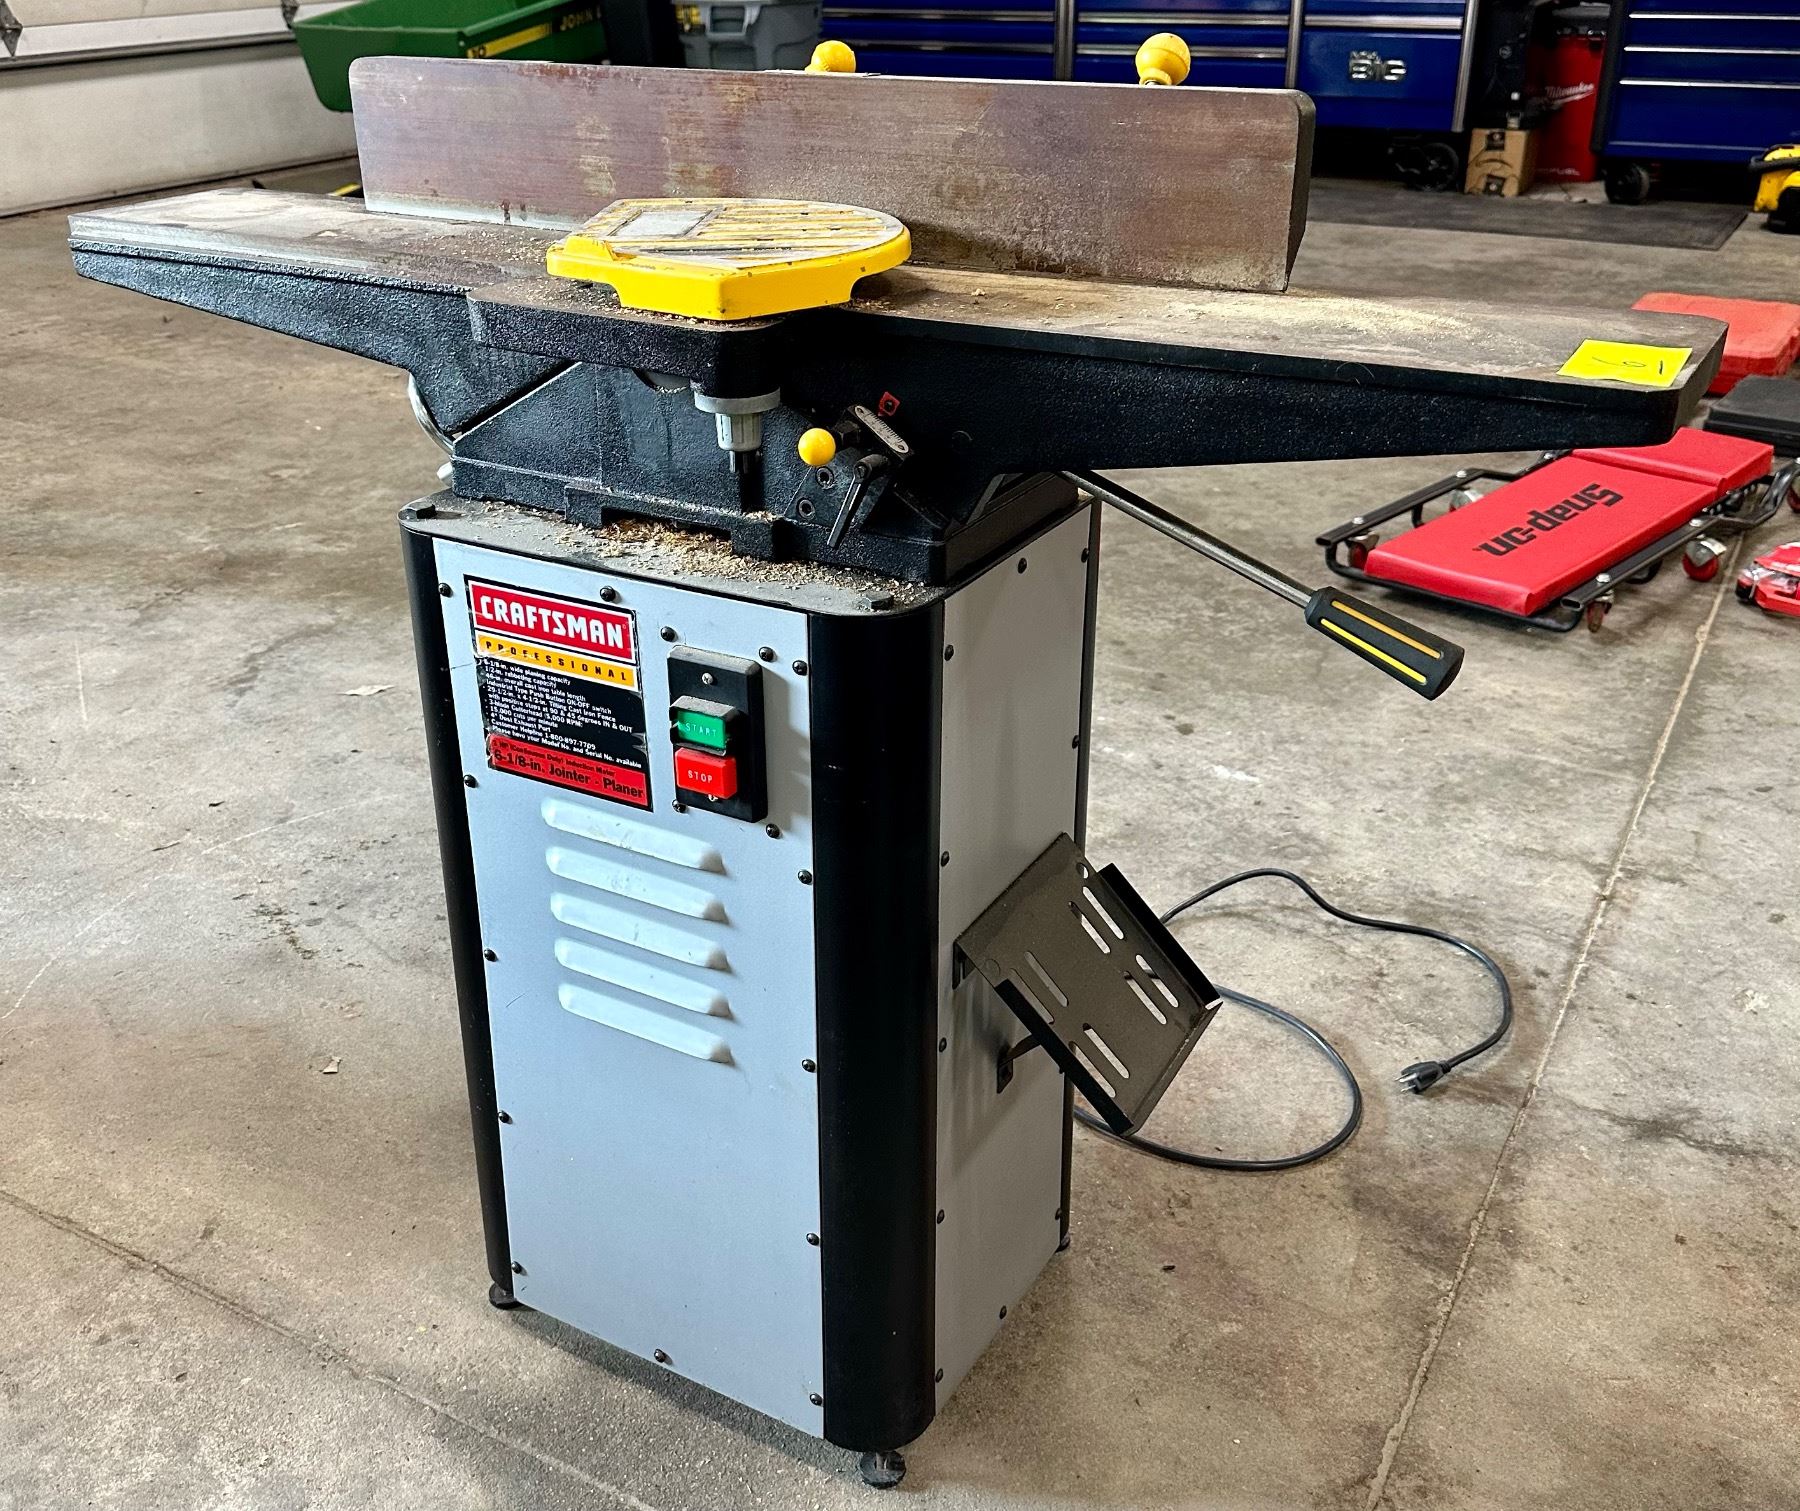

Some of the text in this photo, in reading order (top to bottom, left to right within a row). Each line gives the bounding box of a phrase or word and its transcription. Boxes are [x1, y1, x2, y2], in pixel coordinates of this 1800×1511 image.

[1544, 81, 1595, 99] Milwaukee
[1476, 483, 1623, 556] Snap-on
[480, 595, 623, 649] CRAFTSMAN
[485, 641, 627, 681] PROFESSIONAL
[546, 673, 571, 685] capacity
[514, 685, 527, 695] Type
[529, 688, 544, 698] Push
[545, 692, 565, 703] Button
[549, 707, 558, 715] 90
[566, 711, 575, 719] 45
[576, 714, 601, 727] degrees
[618, 723, 633, 733] OUT
[568, 704, 582, 714] Cast
[583, 708, 595, 717] Iron
[597, 711, 615, 722] Fence
[491, 718, 518, 730] Customer
[499, 714, 512, 722] Dust
[537, 723, 550, 732] Port
[685, 722, 717, 737] START
[512, 730, 525, 739] have
[541, 737, 560, 747] Model
[572, 745, 583, 753] and
[585, 748, 602, 758] Serial
[615, 756, 641, 768] available
[494, 748, 545, 772] 6-1/8-in.
[548, 762, 590, 784] Jointer
[602, 777, 643, 799] Planer
[687, 770, 713, 784] STOP
